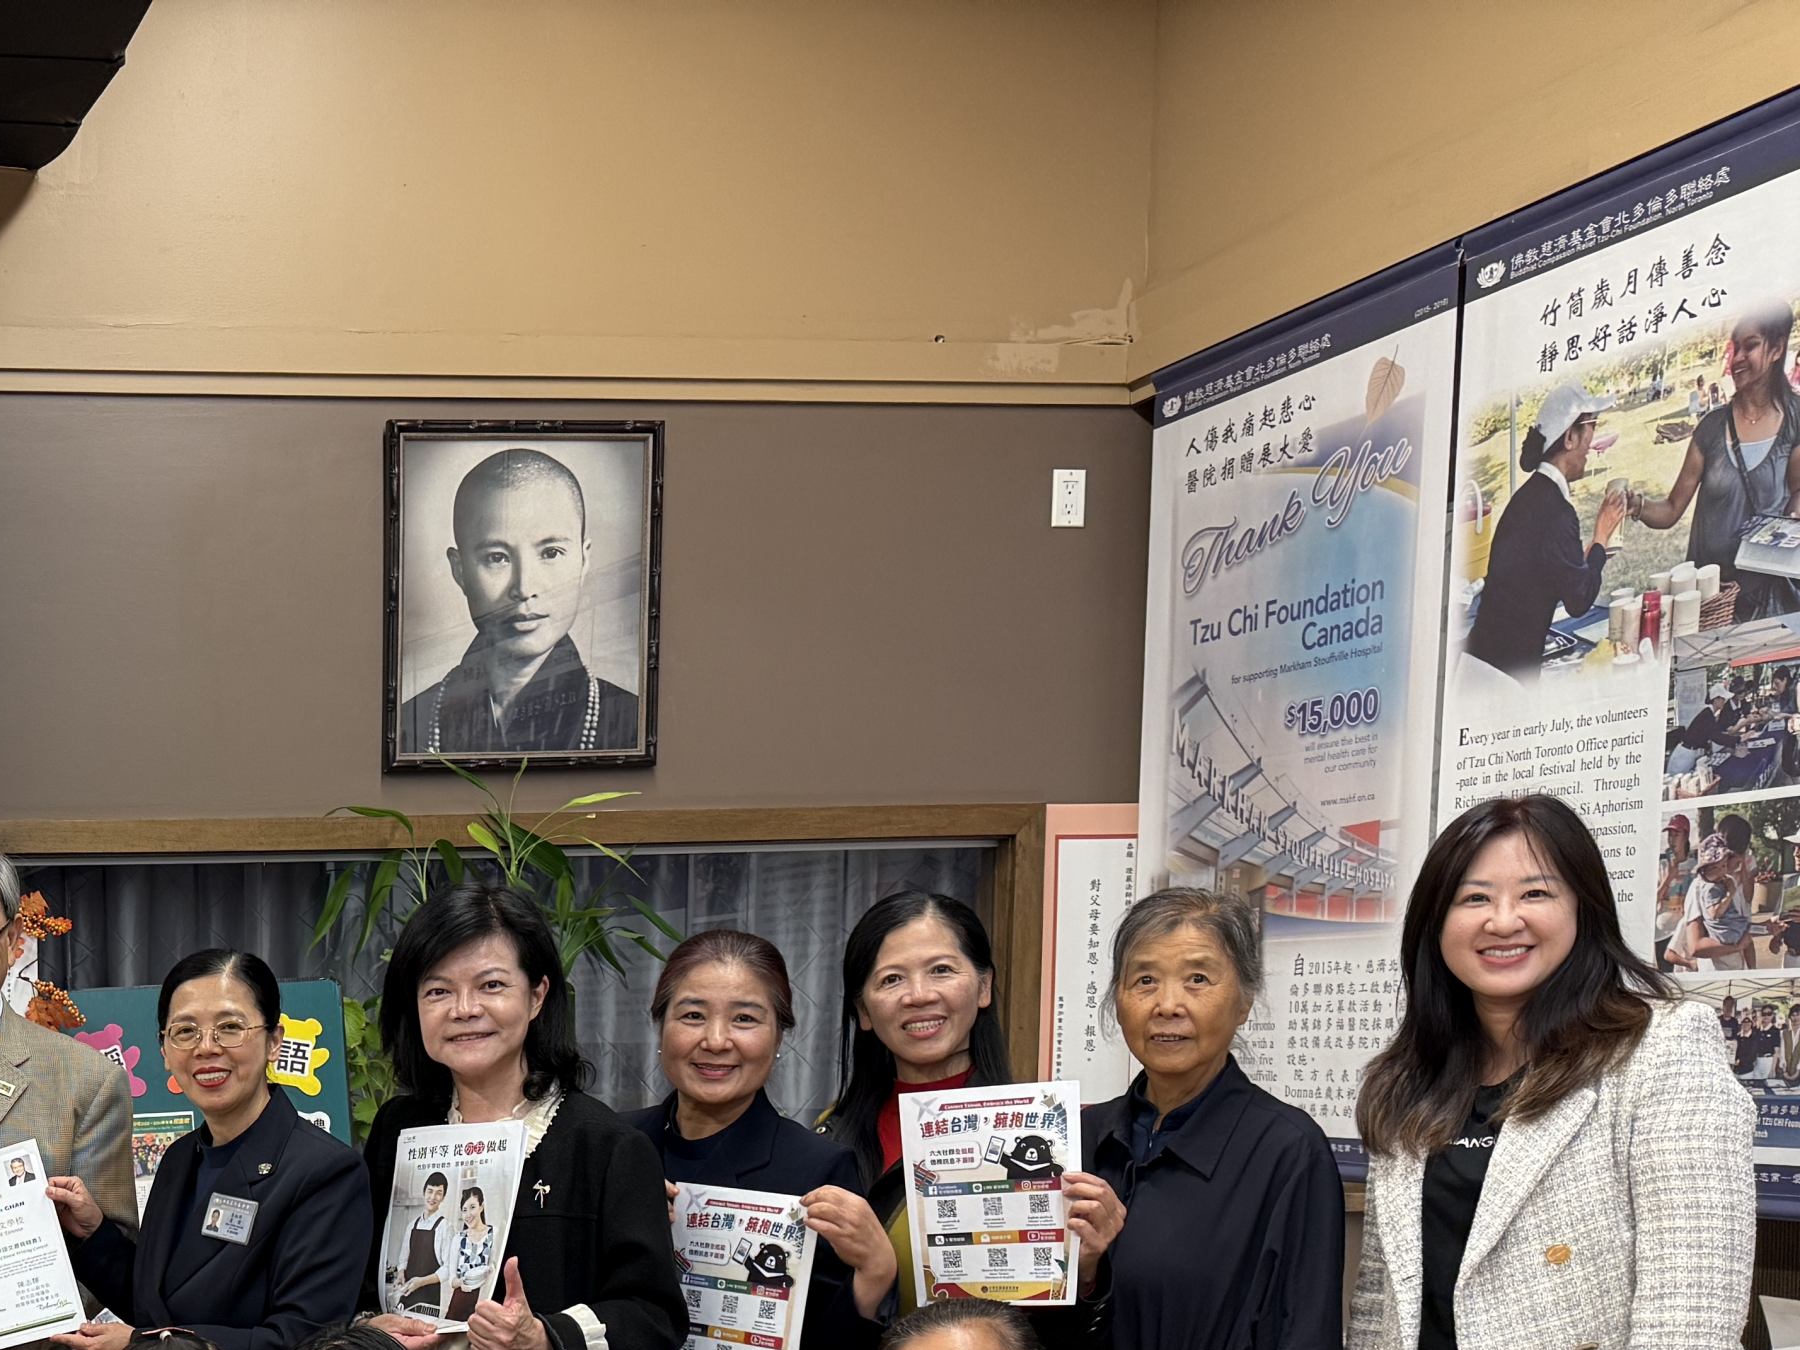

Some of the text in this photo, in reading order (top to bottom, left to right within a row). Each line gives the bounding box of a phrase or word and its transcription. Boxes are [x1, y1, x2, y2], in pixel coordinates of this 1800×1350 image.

[1540, 234, 1731, 327] 竹筒歲月傳善念
[1536, 288, 1727, 373] 靜思好話淨人心
[1186, 394, 1316, 458] 人傷我痛起悲心
[1186, 426, 1314, 494] 醫院捐贈展大愛
[1182, 438, 1412, 596] Thank You
[1190, 578, 1384, 645] Tzu Chi Foundation
[1302, 607, 1383, 650] Canada
[1232, 642, 1383, 684] for supporting Markham Stouffville Hospital
[1286, 688, 1380, 734] $15,000
[1459, 707, 1648, 746] Every year in early July, the volunteers
[1327, 749, 1350, 761] health
[1341, 736, 1353, 746] the
[1355, 735, 1370, 744] best
[1457, 730, 1644, 770] of Tzu Chi North Toronto Office partici
[1338, 759, 1376, 773] community
[1456, 751, 1641, 790] -pate in the local festival held by the
[1538, 774, 1640, 798] Council. Through
[1580, 798, 1643, 817] Si Aphorism
[1626, 845, 1636, 857] to
[1618, 890, 1633, 902] the
[279, 1040, 310, 1075] 語
[920, 1112, 1056, 1138] 連結台灣，擁抱世界
[1763, 1118, 1783, 1127] TZU CHI
[408, 1140, 508, 1161] 性別平等 從你我做起
[5, 1201, 25, 1211] CHAN
[686, 1212, 799, 1240] 連結台灣，擁抱世界
